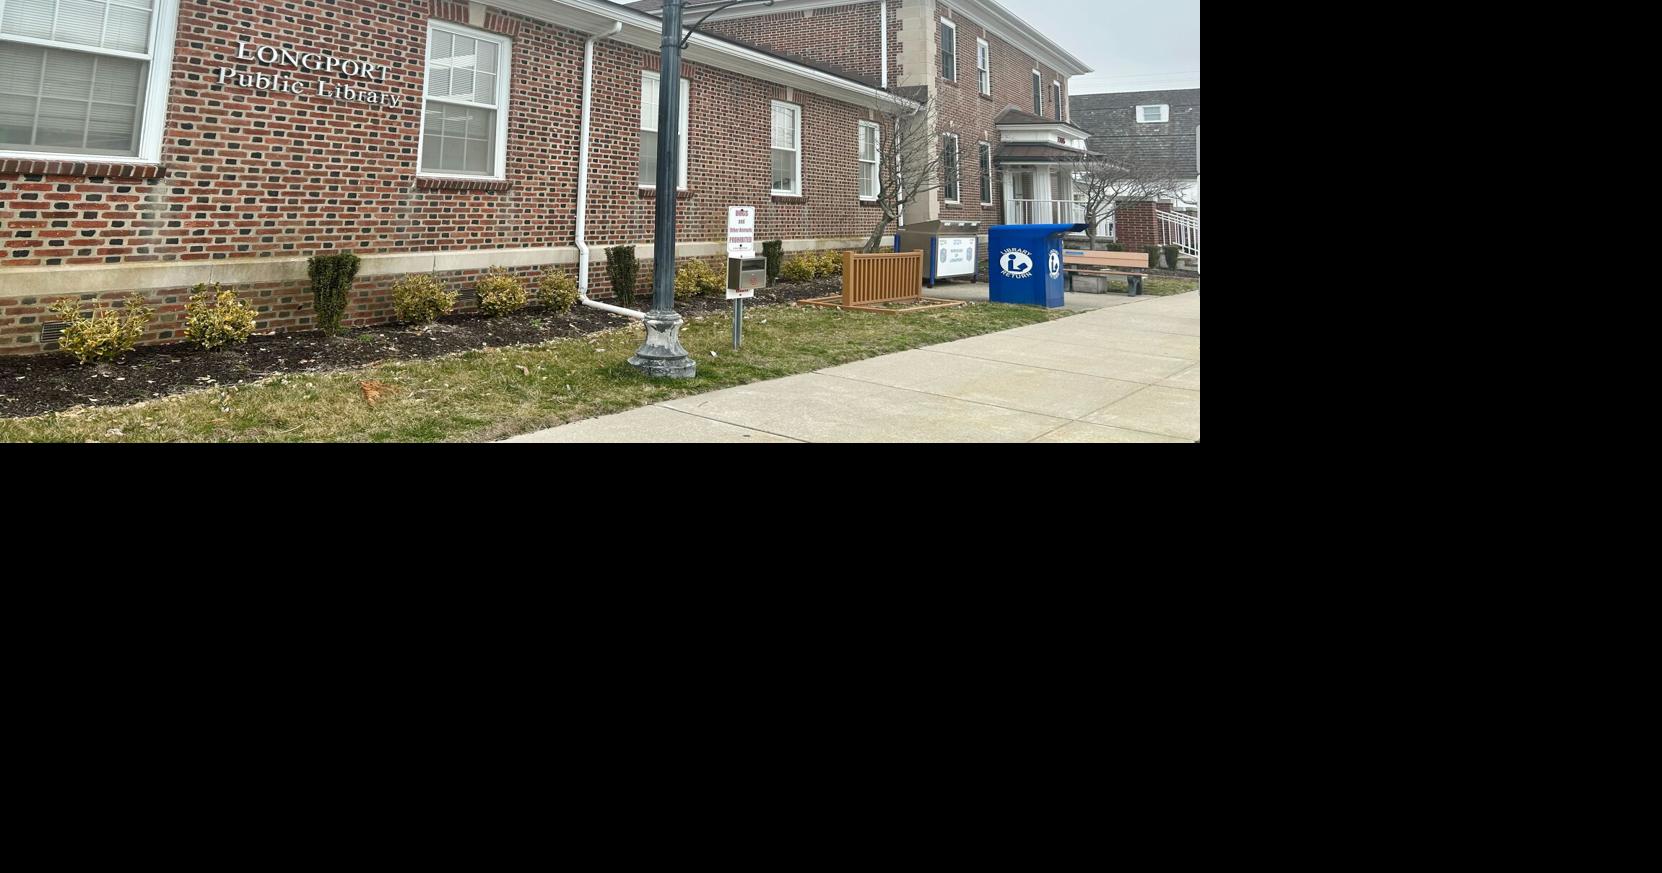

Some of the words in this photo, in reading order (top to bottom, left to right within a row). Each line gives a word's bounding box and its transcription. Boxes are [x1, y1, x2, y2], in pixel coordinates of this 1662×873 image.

[236, 41, 392, 81] LONGPORT
[218, 66, 304, 94] Public
[316, 80, 401, 109] Library
[1000, 247, 1032, 256] LIBRARY
[1000, 269, 1032, 279] RETURN
